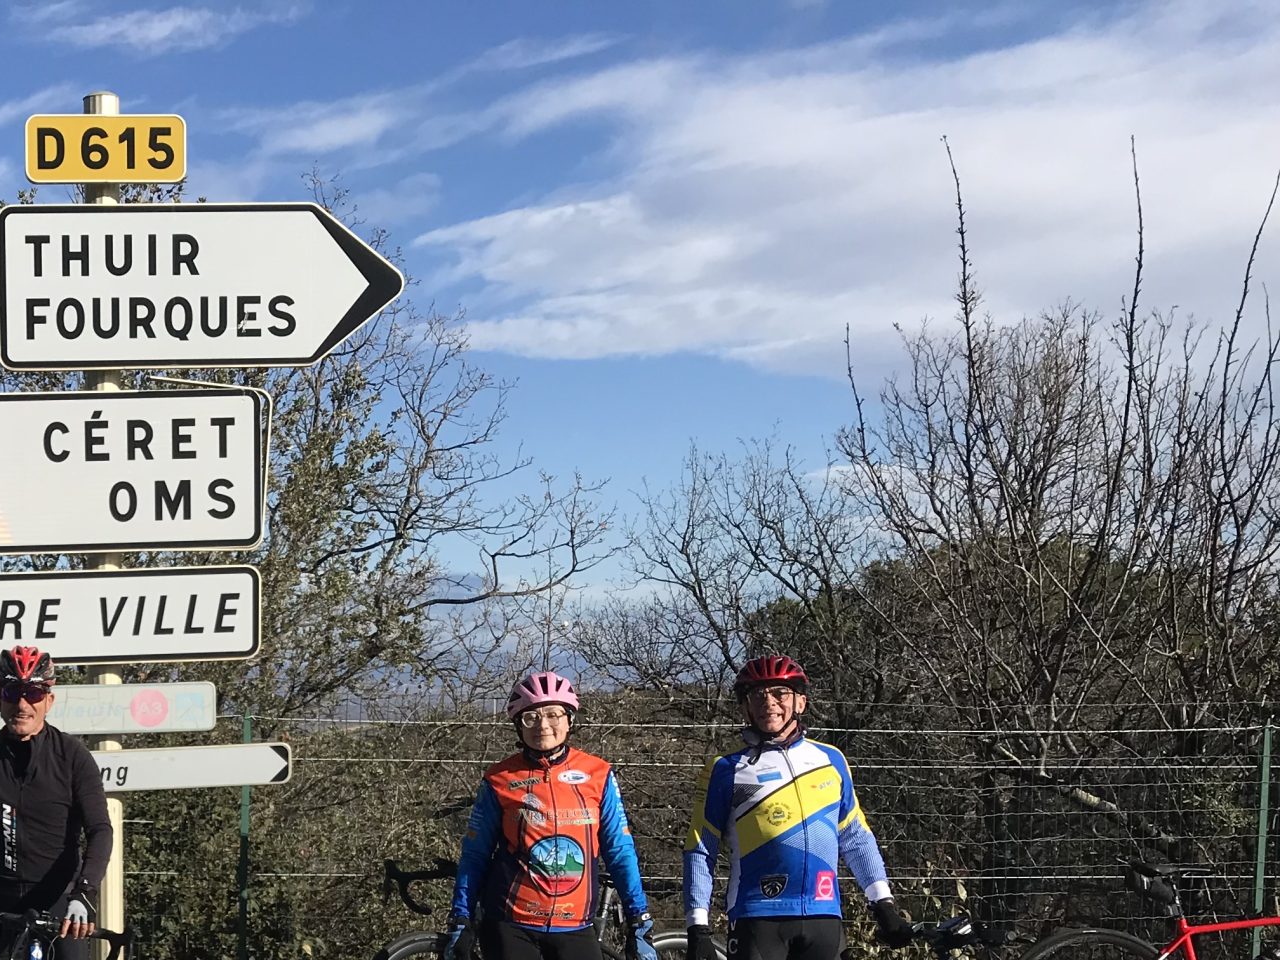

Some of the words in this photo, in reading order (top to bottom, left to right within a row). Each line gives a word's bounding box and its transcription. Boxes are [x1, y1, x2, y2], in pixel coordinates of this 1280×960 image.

[80, 127, 175, 170] 615
[24, 233, 201, 277] THUIR
[25, 295, 298, 341] FOURQUES
[43, 410, 236, 463] CÉRET
[109, 478, 237, 523] OMS
[99, 592, 241, 637] VILLE
[100, 766, 128, 787] ng
